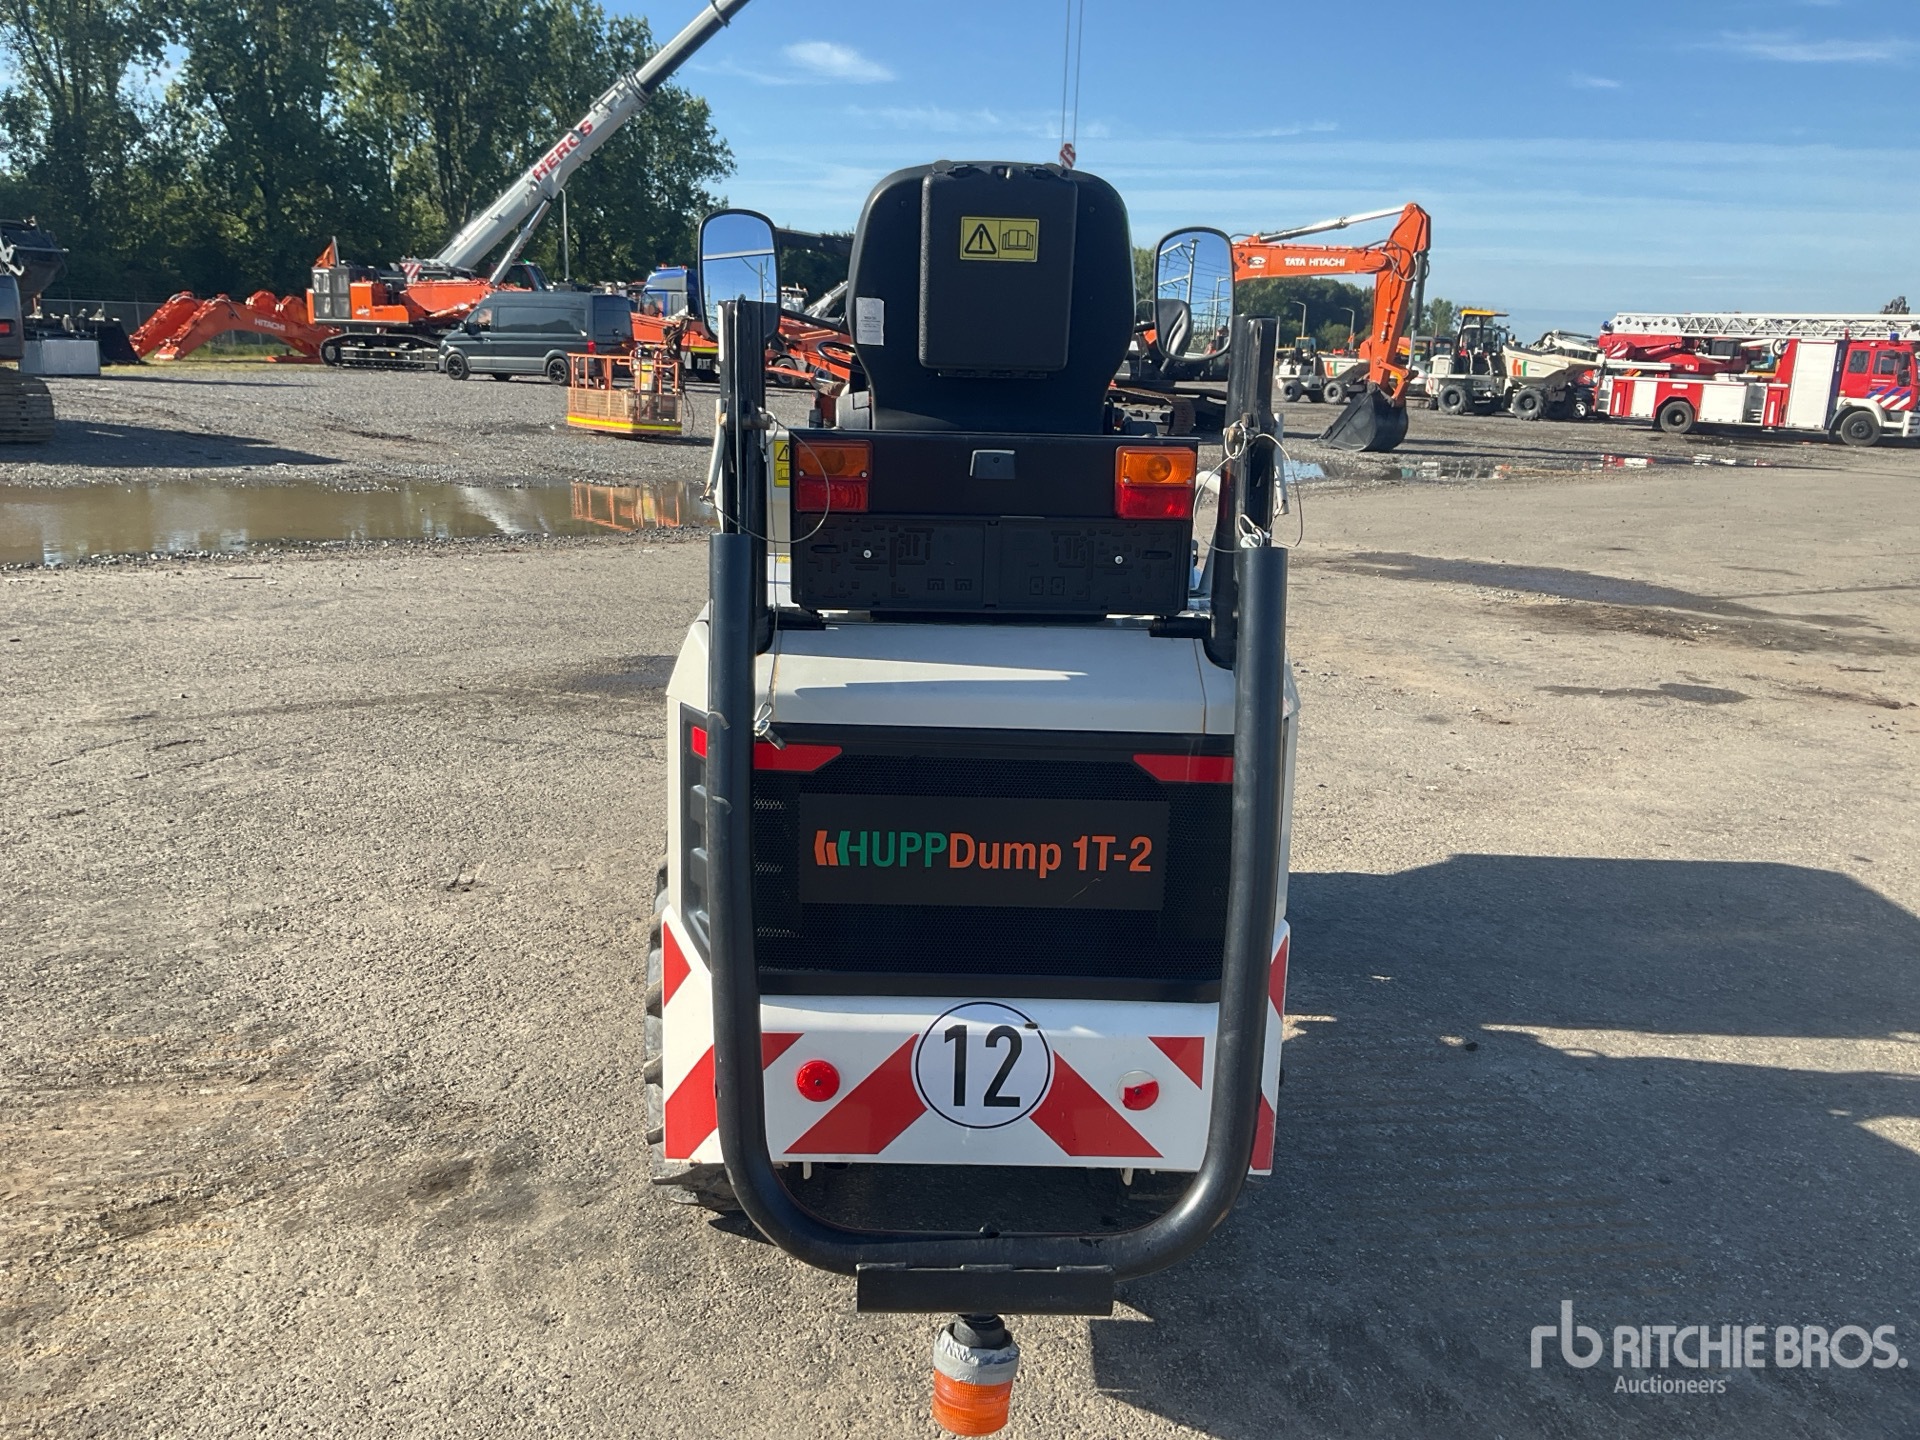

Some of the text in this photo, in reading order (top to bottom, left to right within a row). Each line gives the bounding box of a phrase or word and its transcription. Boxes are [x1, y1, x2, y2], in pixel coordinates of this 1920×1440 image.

[1284, 257, 1346, 267] TATA HITACHI
[254, 317, 286, 331] HITACHI
[1072, 834, 1152, 872] 1T-2
[943, 1024, 1023, 1108] 12
